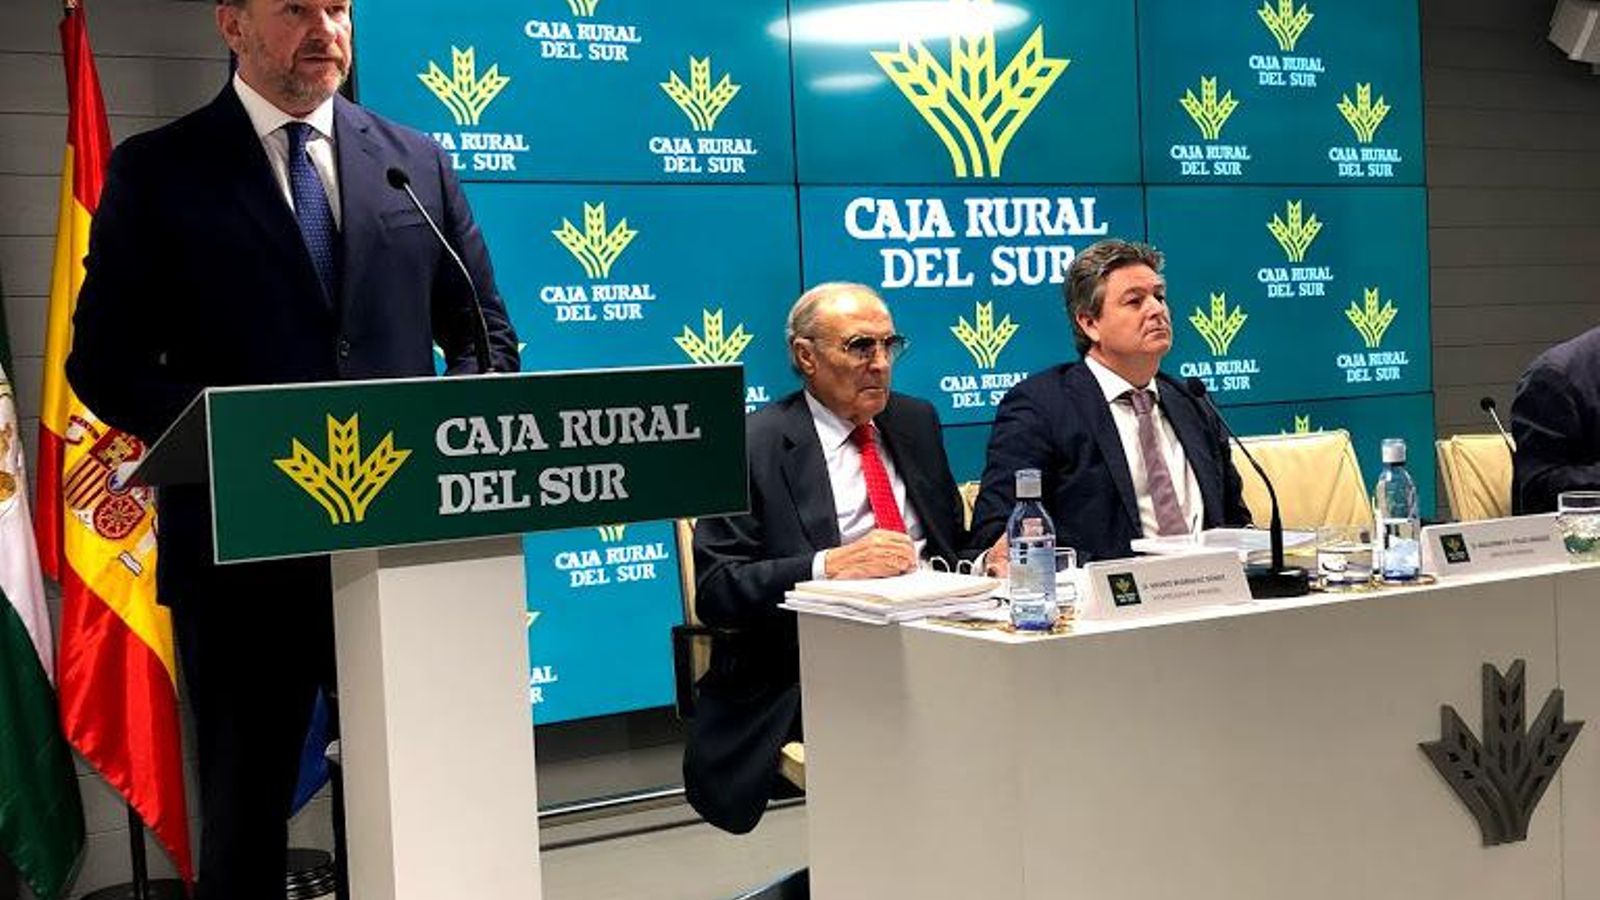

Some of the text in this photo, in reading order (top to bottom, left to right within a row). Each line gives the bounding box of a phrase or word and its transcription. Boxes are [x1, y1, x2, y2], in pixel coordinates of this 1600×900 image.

[525, 20, 641, 42] CAJA RURAL
[541, 42, 629, 61] DEL SUR
[1249, 55, 1325, 73] CAJA RURAL
[1259, 72, 1317, 87] DEL SUR
[461, 132, 530, 152] RURAL
[650, 137, 757, 157] CAJA RURAL
[473, 153, 516, 171] SUR
[1170, 145, 1250, 162] CAJA RURAL
[1328, 147, 1401, 164] CAJA RURAL
[664, 156, 746, 174] DEL SUR
[1181, 161, 1242, 176] DEL SUR
[1338, 163, 1393, 177] DEL SUR
[845, 197, 1108, 242] CAJA RURAL
[881, 247, 974, 289] DEL
[1257, 267, 1333, 284] CAJA RURAL
[540, 284, 656, 305] CAJA RURAL
[1268, 282, 1325, 298] DEL SUR
[556, 303, 643, 322] DEL SUR
[1180, 359, 1260, 378] CAJA RURAL
[1336, 351, 1408, 370] CAJA RURAL
[940, 375, 979, 392] CAJA
[1222, 375, 1251, 391] SUR
[1347, 367, 1400, 383] DEL SUR
[952, 390, 986, 409] DEL
[436, 403, 701, 457] CAJA RURAL
[438, 463, 629, 515] DEL SUR
[555, 543, 669, 570] CAJA RURAL
[570, 563, 656, 588] DEL SUR
